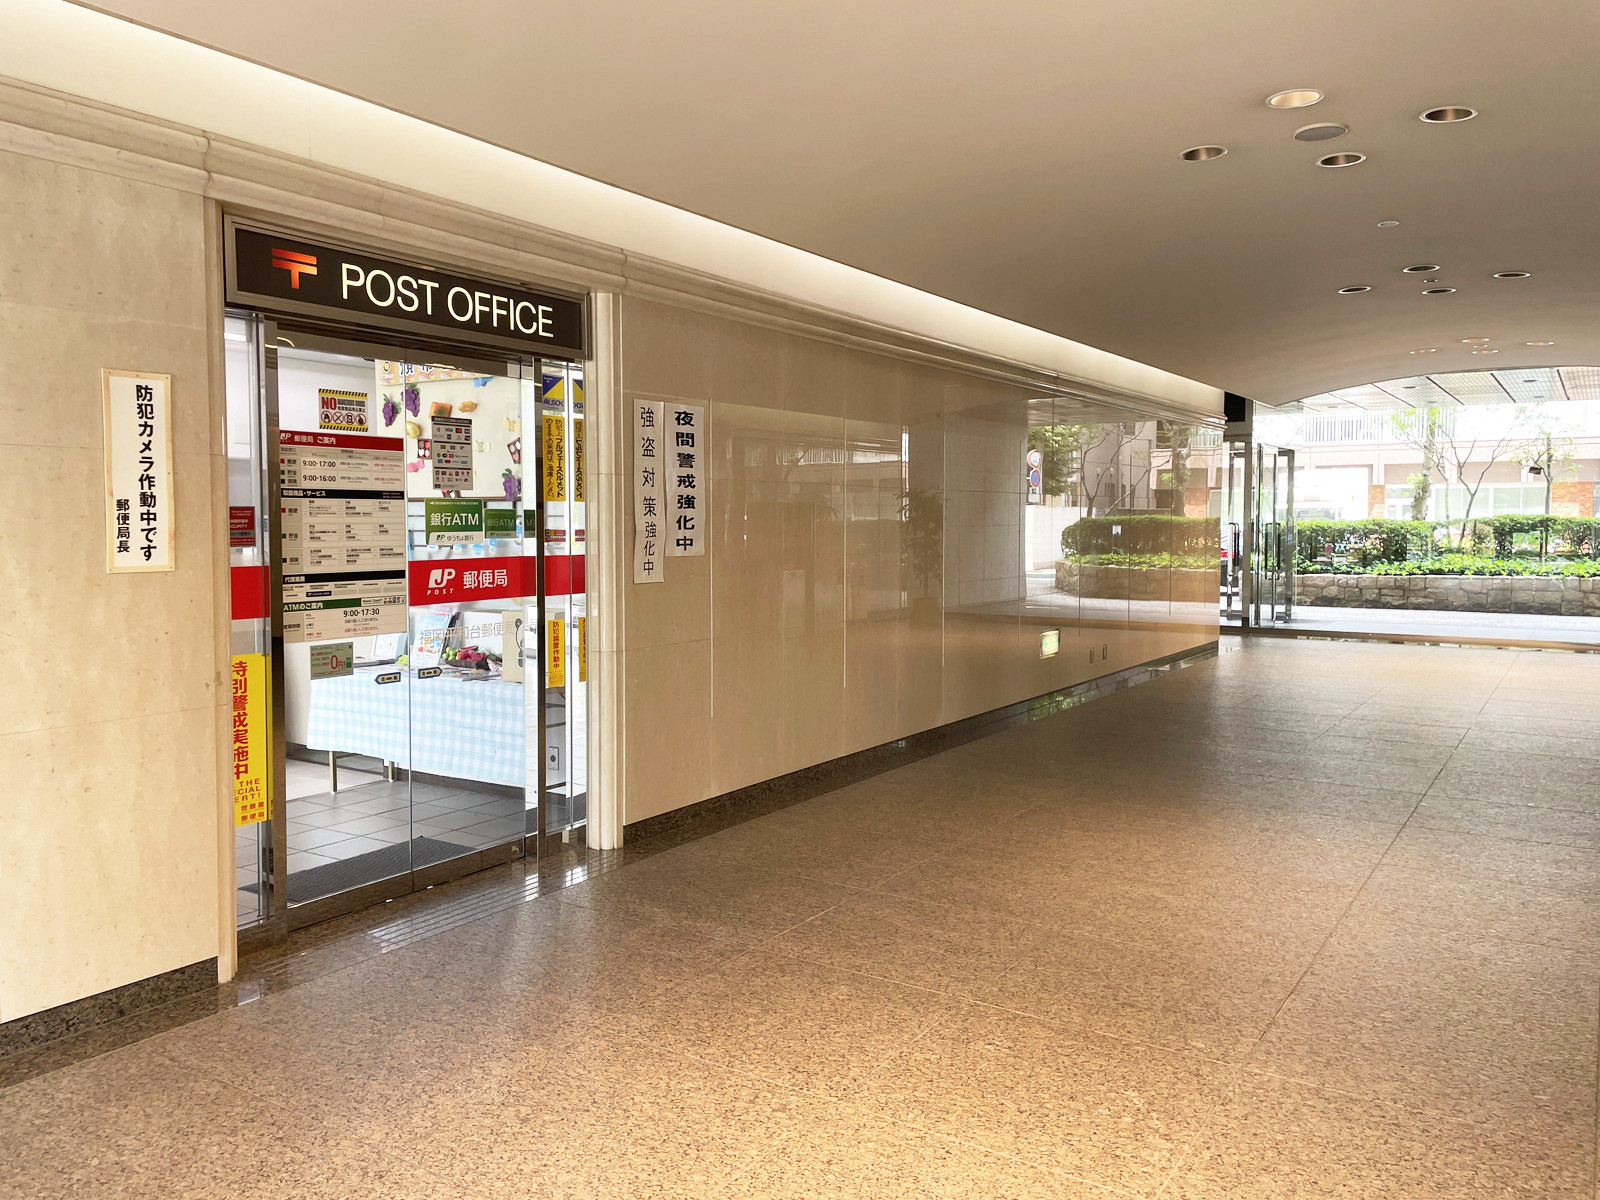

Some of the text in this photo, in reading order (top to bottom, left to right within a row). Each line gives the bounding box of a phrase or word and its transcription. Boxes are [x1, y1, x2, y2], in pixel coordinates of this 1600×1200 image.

[341, 262, 554, 338] POST OFFICE
[321, 396, 337, 410] NO
[316, 436, 336, 445] ご案内
[302, 459, 336, 467] 9:00-17:00
[136, 384, 157, 562] 防犯カメラ作動中です
[302, 474, 337, 483] 9:00-16:00
[674, 410, 697, 552] 夜間警戒強化中
[640, 406, 657, 576] 強盗対策強化中
[430, 512, 479, 526] 銀行ATM
[116, 498, 131, 554] 郵便局長
[447, 534, 474, 542] ゆうちょ銀行
[463, 569, 508, 589] 郵便局
[283, 602, 324, 611] ATMのご案内
[343, 608, 380, 618] 9:00-17:30
[238, 777, 260, 788] THE
[234, 785, 261, 796] CIAL
